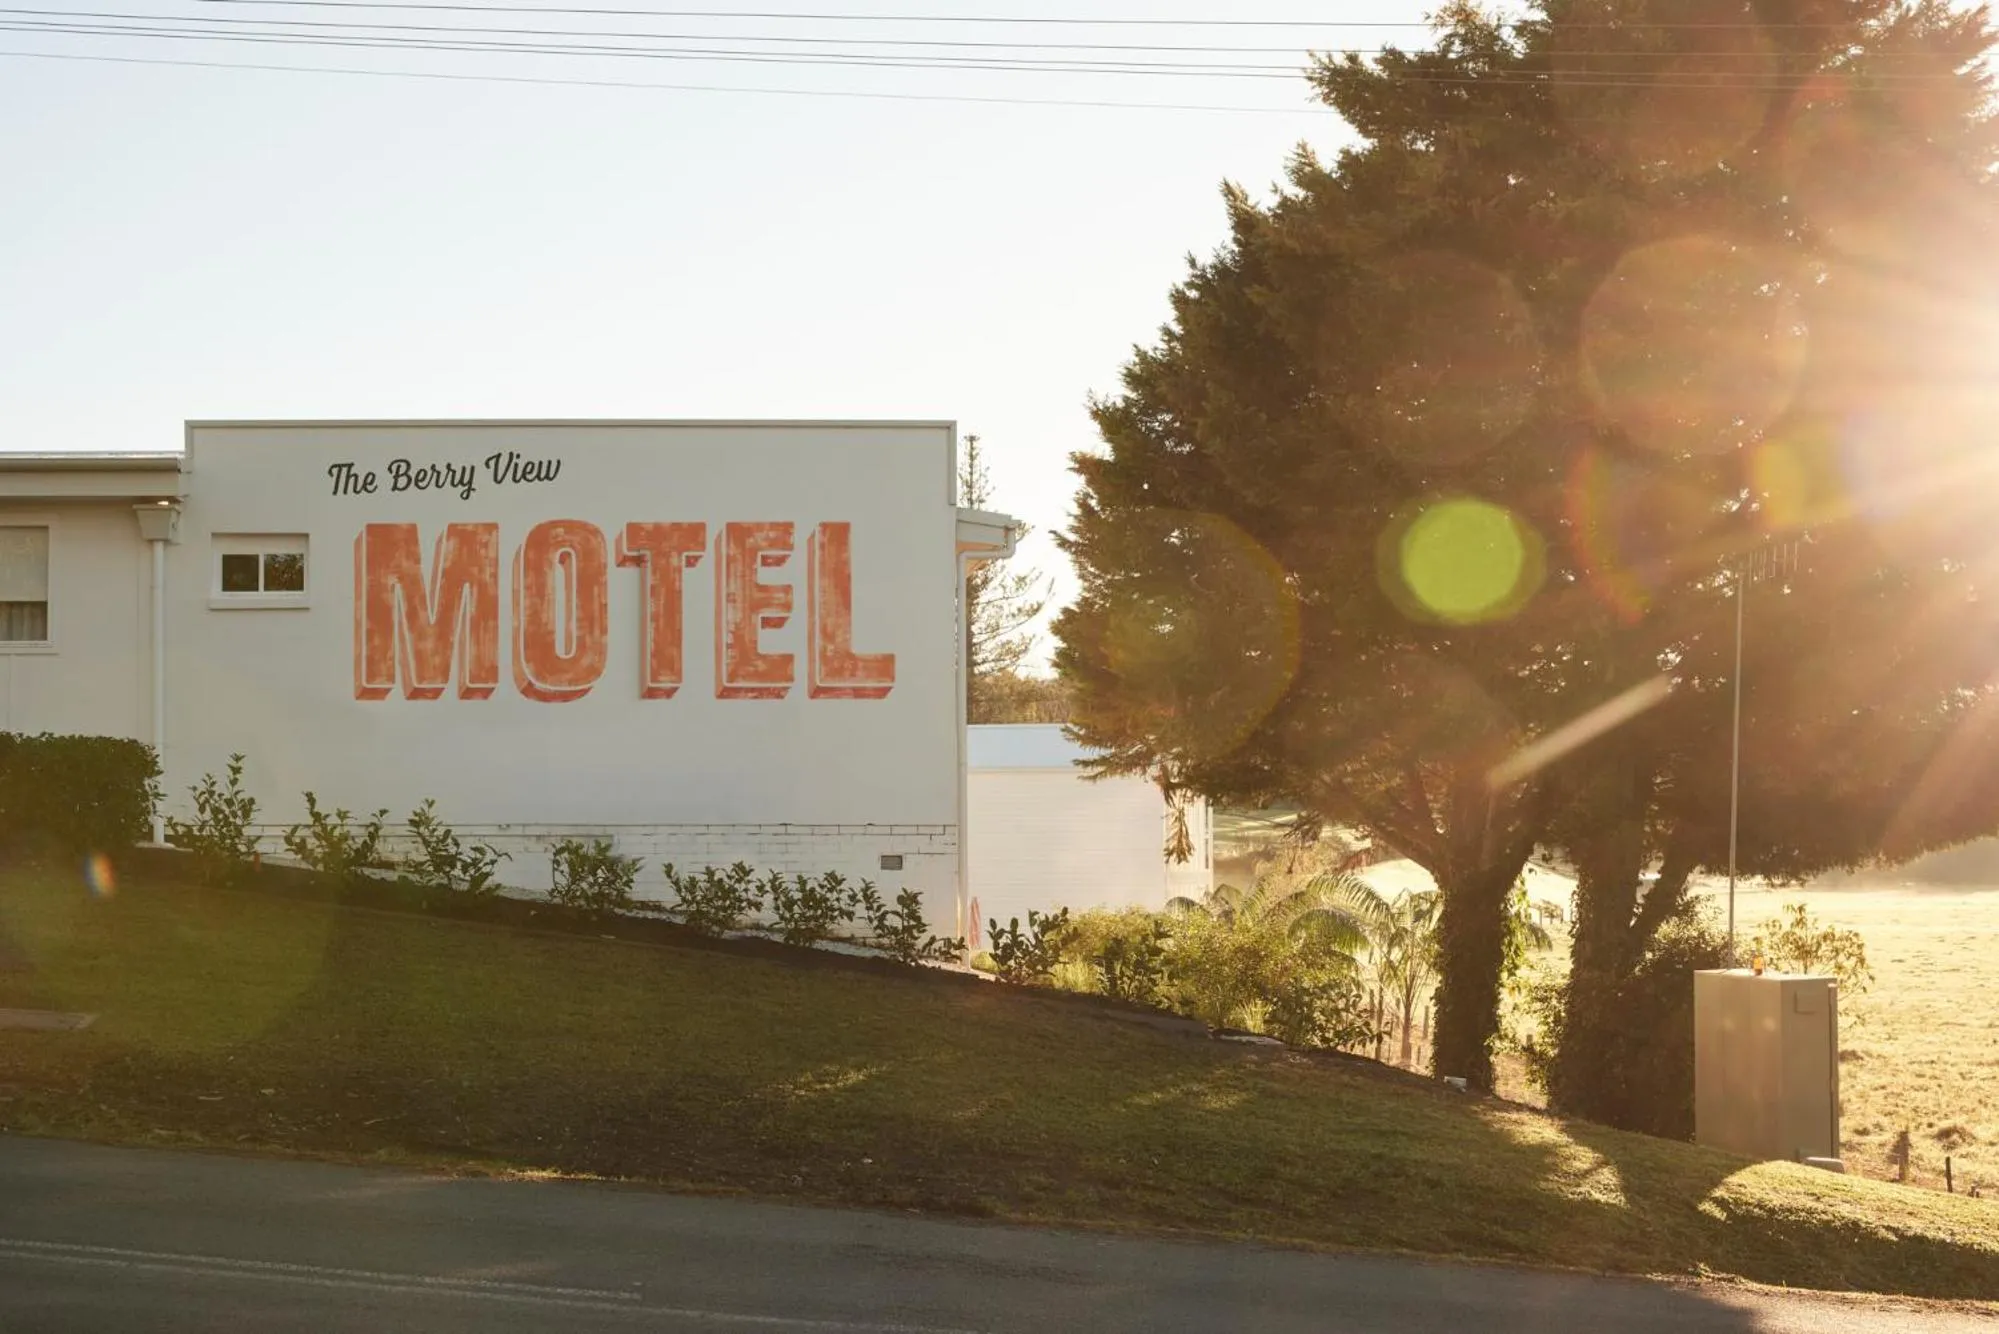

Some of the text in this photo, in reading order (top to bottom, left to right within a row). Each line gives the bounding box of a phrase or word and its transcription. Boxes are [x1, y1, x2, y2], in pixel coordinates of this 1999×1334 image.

[328, 451, 561, 500] The Berry View
[354, 519, 896, 703] MOTEL
